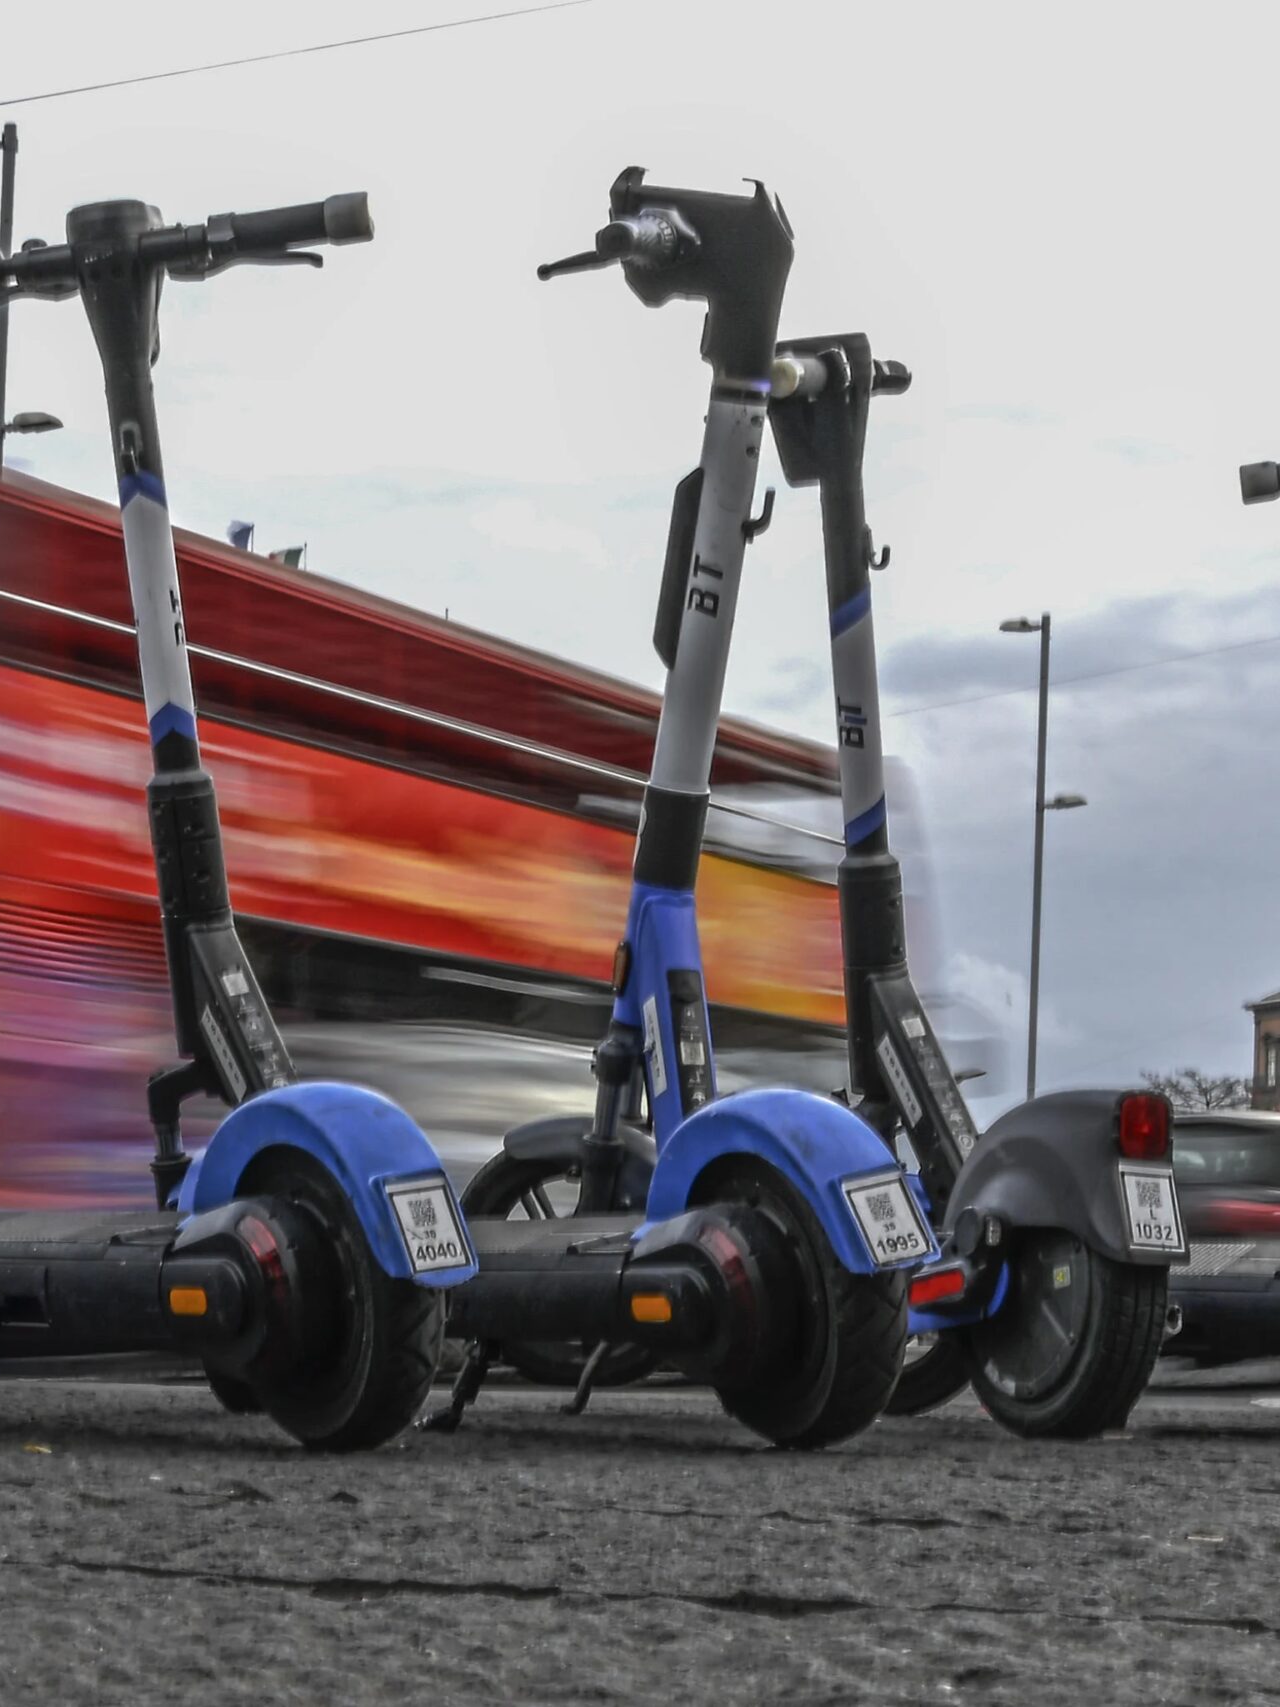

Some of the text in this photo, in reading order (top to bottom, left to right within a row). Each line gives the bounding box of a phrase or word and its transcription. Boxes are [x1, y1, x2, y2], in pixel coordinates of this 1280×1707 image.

[1136, 1222, 1174, 1241] 1032
[416, 1242, 458, 1262] 4040
[876, 1232, 920, 1255] 1995
